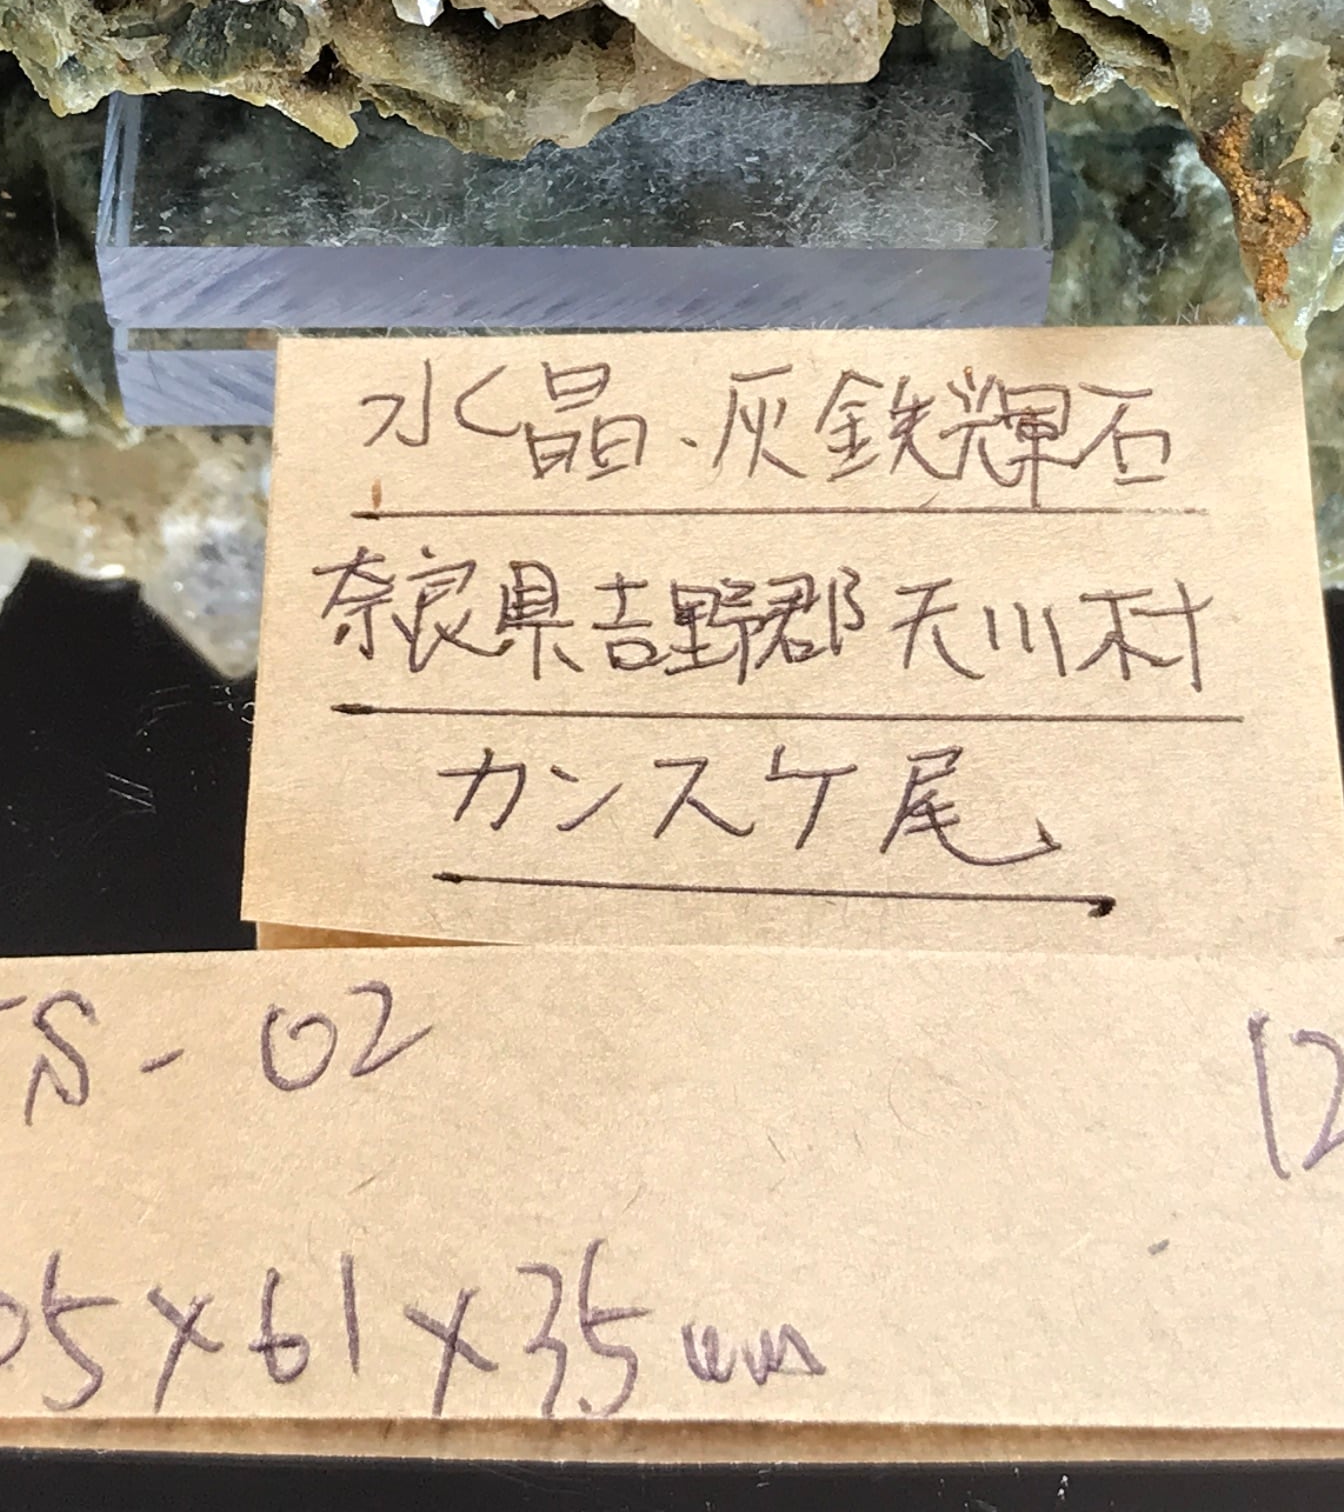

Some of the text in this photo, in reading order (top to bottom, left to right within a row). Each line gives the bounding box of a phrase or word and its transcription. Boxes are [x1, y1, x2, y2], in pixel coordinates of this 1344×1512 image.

[436, 746, 1064, 866] カンスケ尾
